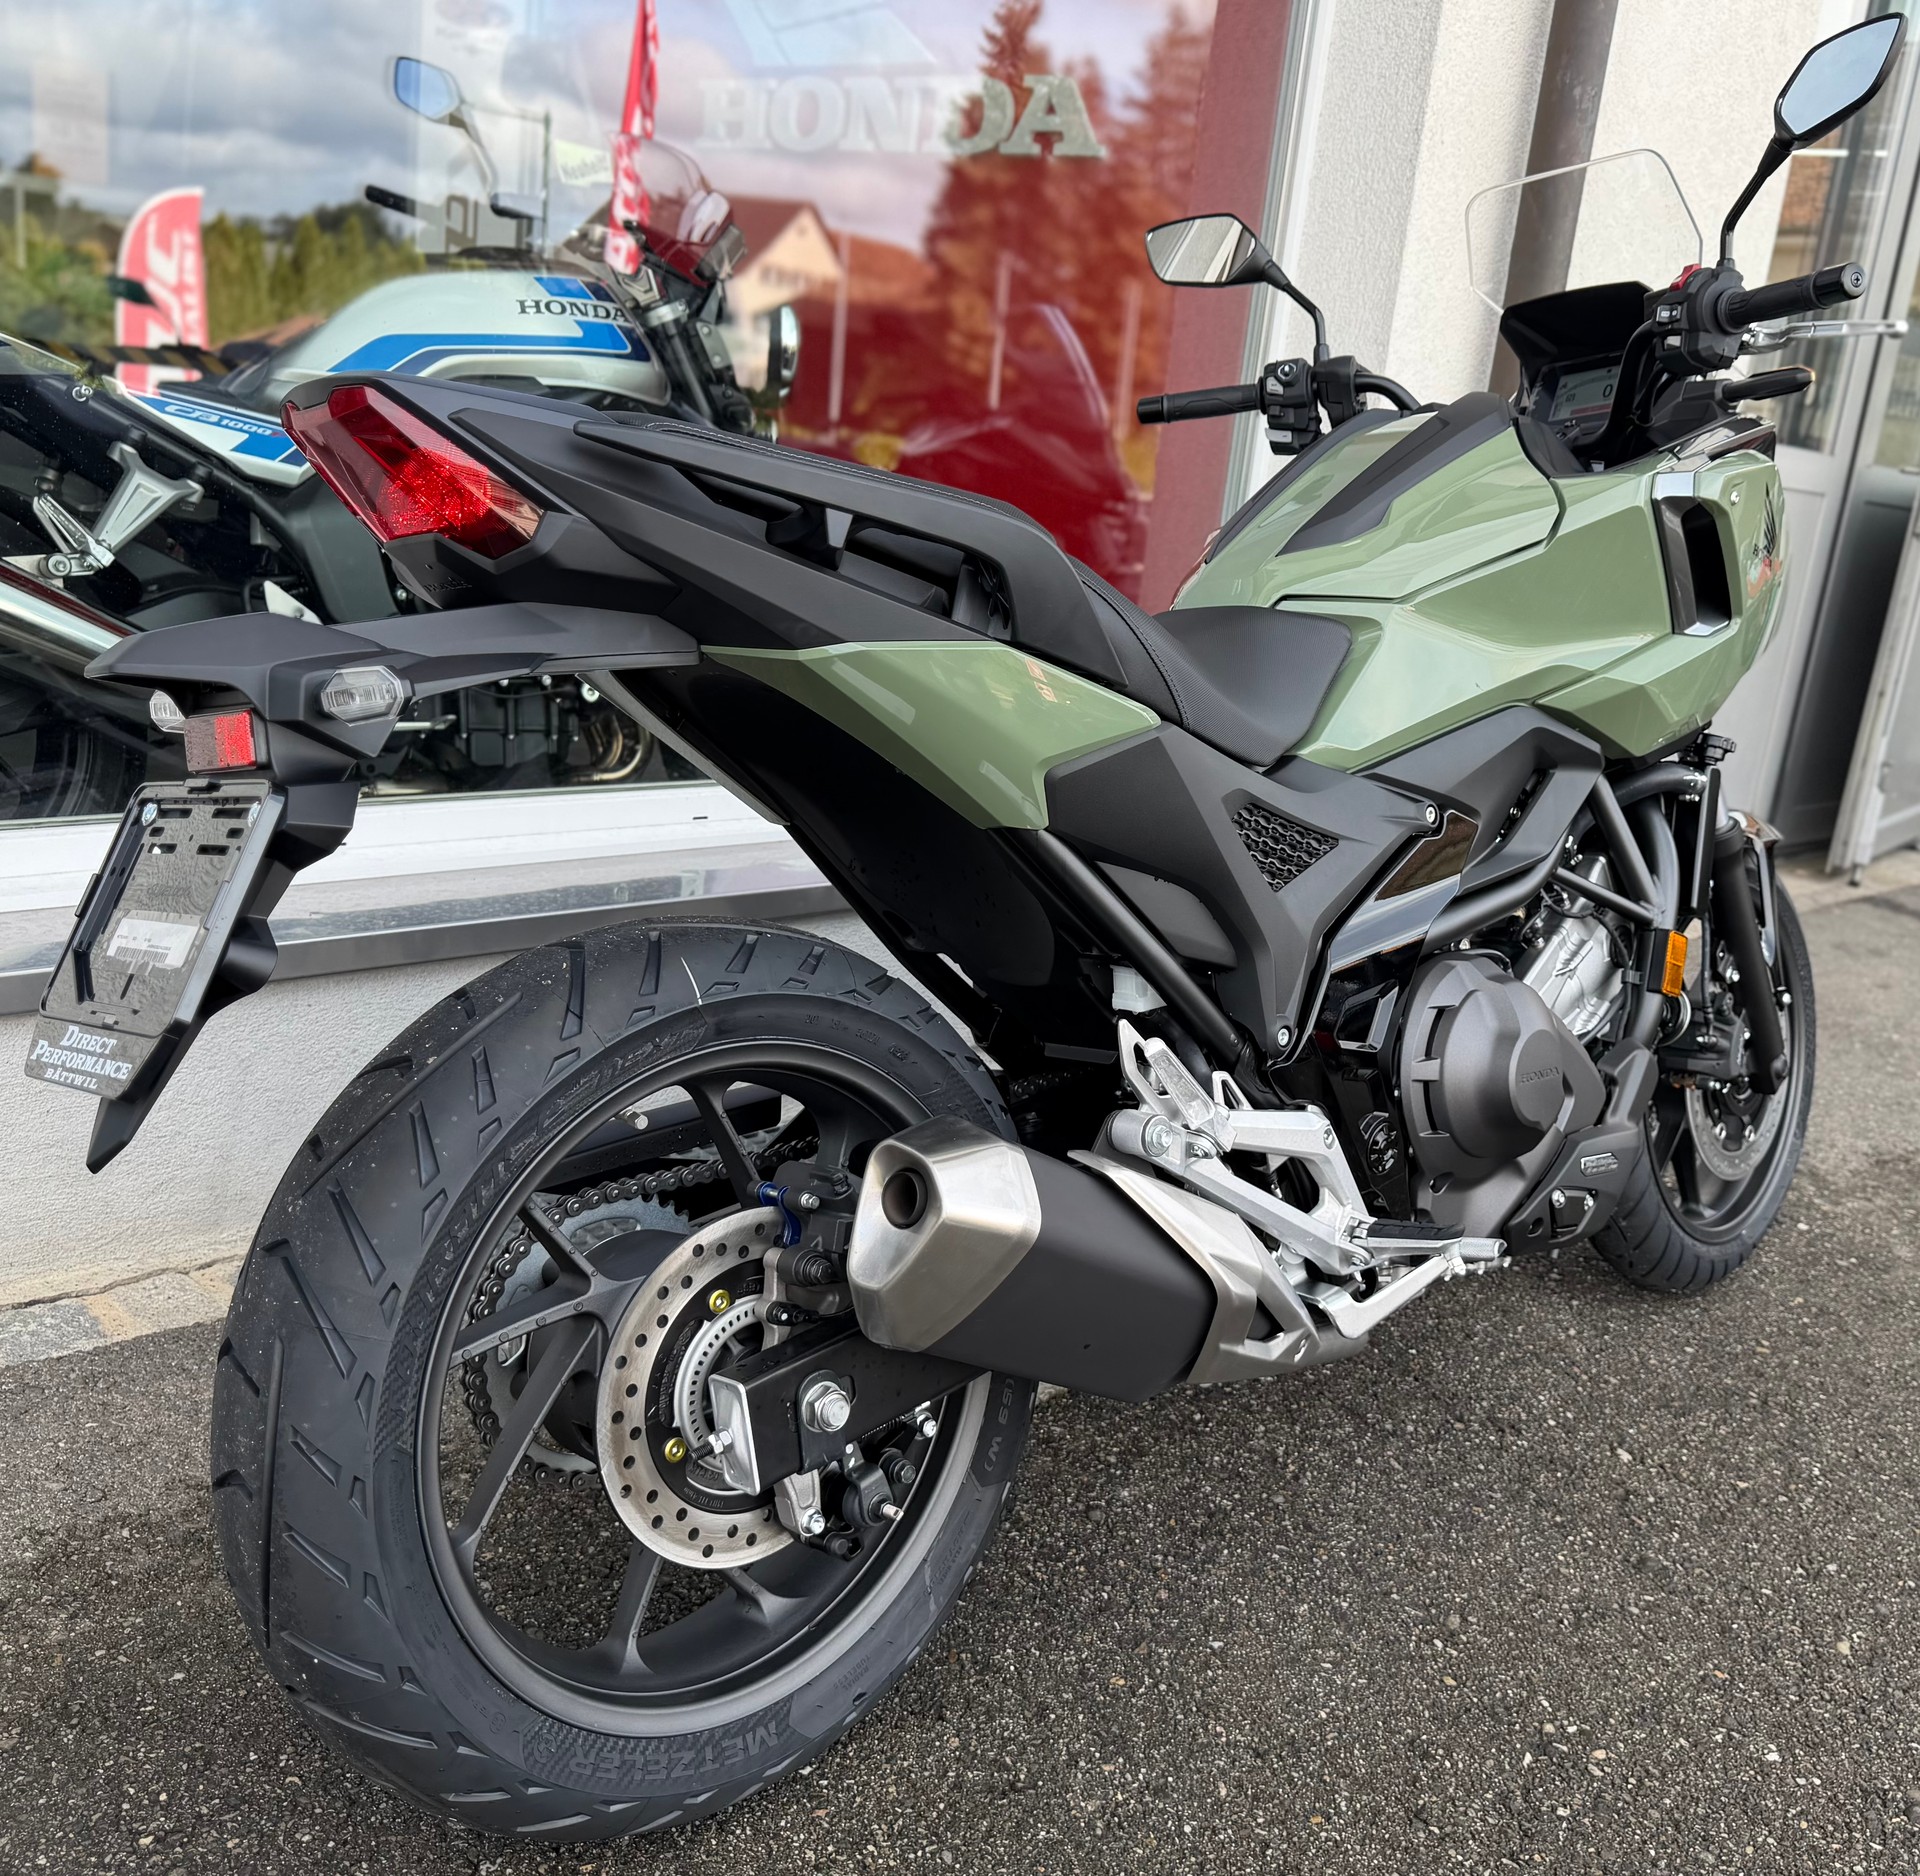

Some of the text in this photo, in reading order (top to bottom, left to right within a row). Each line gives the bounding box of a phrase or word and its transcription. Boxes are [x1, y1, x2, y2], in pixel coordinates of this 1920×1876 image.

[696, 74, 1107, 158] HONDA
[516, 298, 630, 323] HONDA
[60, 1025, 117, 1054] DIRECT
[30, 1039, 133, 1080] PERFORMANCE
[44, 1067, 98, 1090] BÄTTWIL
[1520, 1066, 1560, 1083] HONDA
[569, 1720, 779, 1781] METZELER
